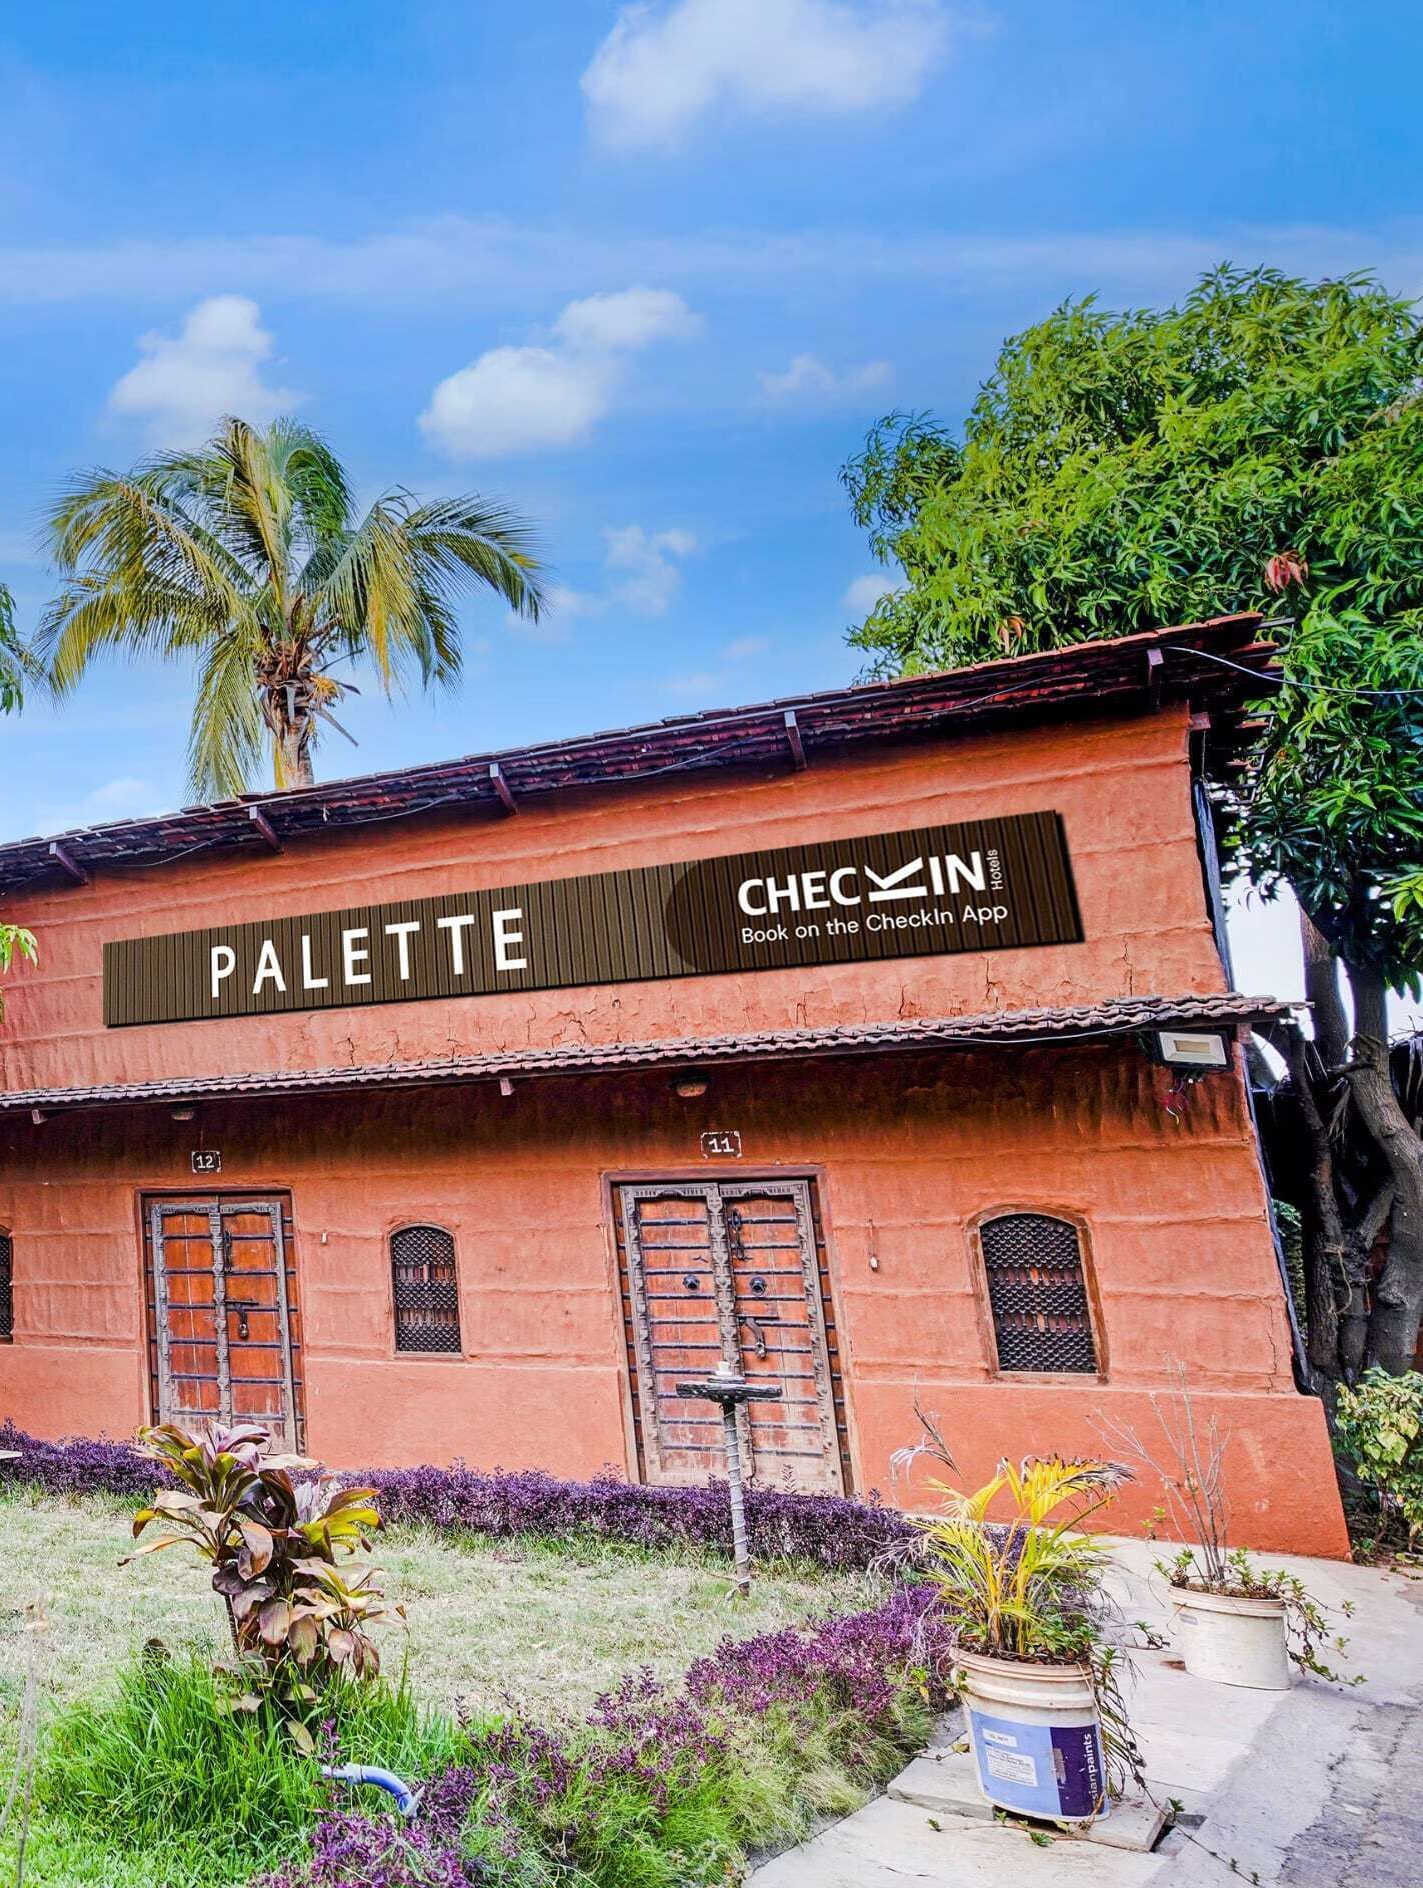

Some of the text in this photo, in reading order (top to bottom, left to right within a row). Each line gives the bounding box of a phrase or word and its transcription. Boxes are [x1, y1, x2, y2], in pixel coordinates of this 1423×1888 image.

[986, 849, 1004, 890] Hotels
[742, 904, 1008, 943] Book on the CheckIn App
[211, 908, 527, 998] PALETTE
[196, 1155, 215, 1169] 12
[708, 1137, 735, 1153] 11
